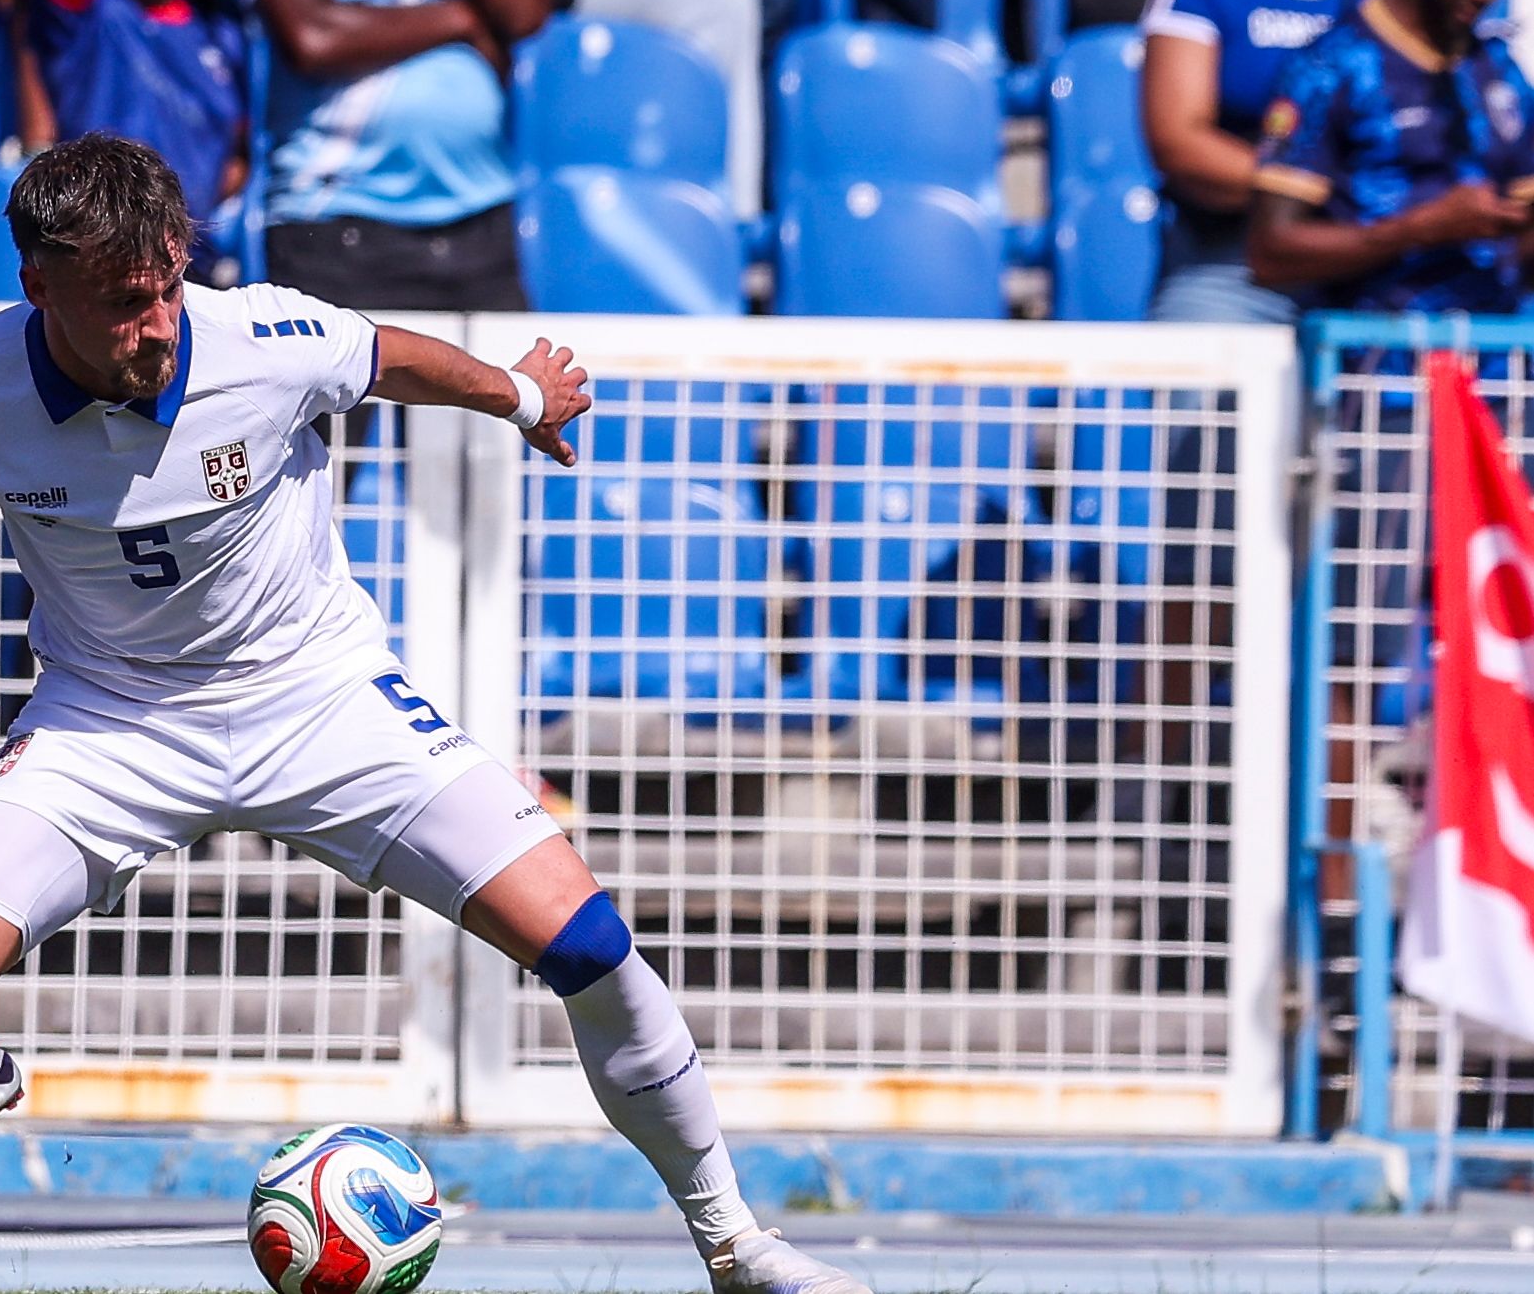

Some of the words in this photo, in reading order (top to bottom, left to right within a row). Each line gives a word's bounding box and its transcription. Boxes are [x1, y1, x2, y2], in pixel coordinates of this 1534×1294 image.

[5, 487, 68, 506] capelli
[35, 501, 68, 509] SPORT
[117, 525, 181, 590] 5
[371, 673, 451, 733] 5
[428, 732, 474, 757] cape
[515, 803, 546, 820] cape
